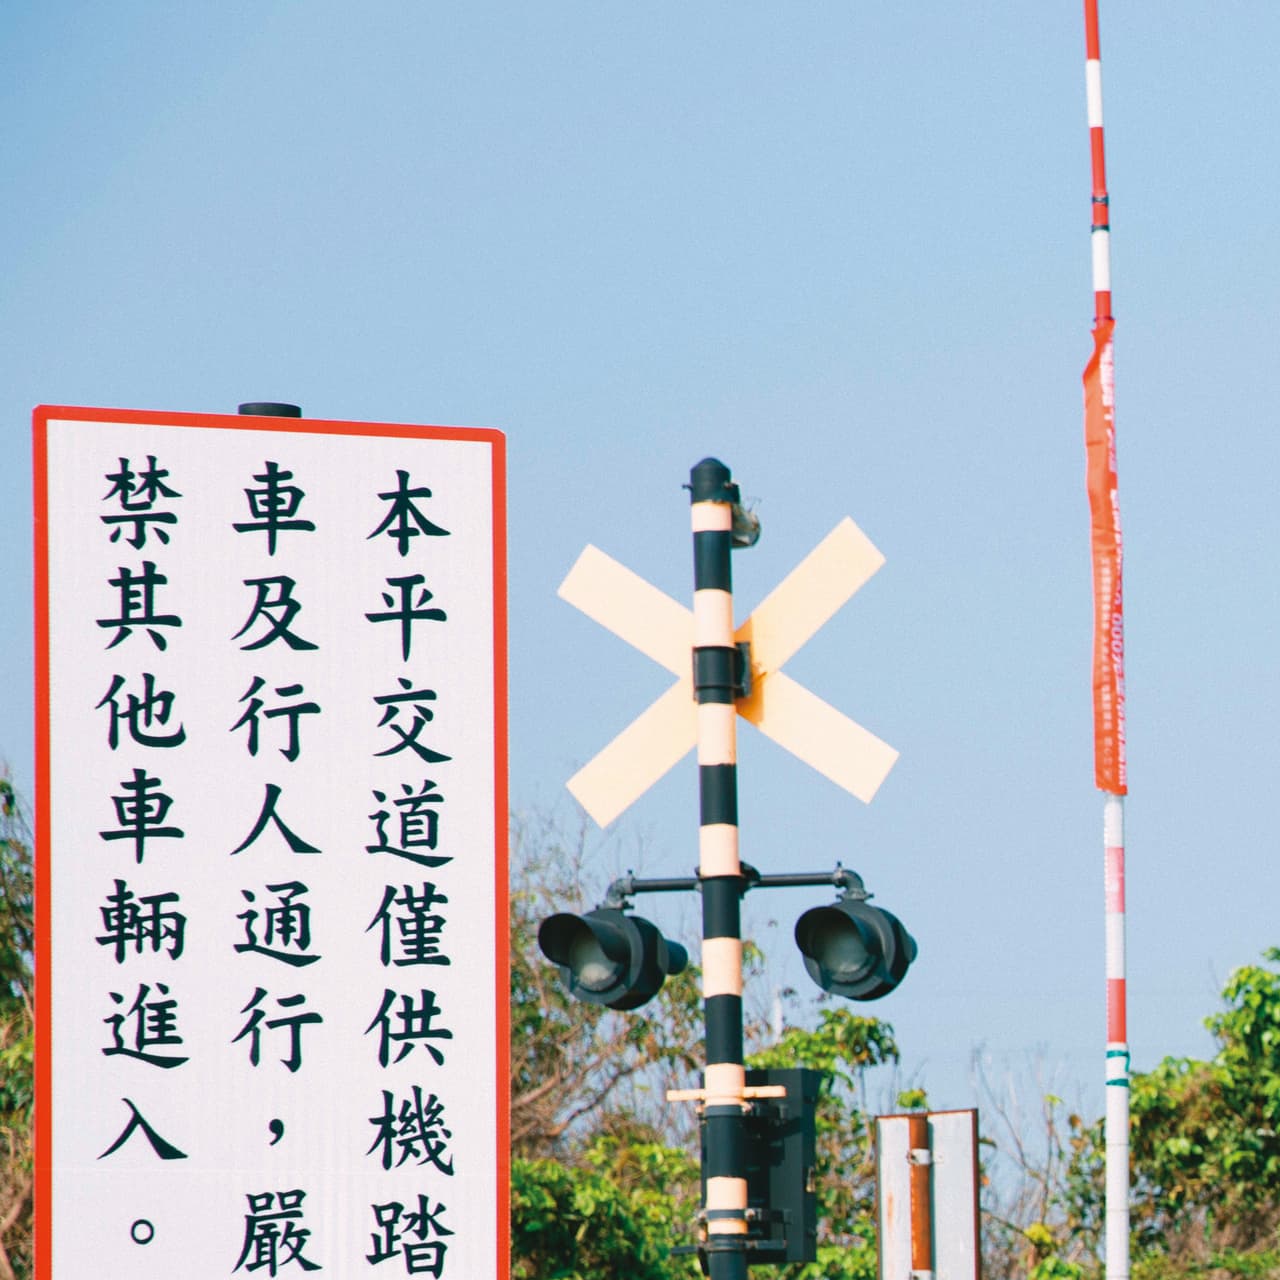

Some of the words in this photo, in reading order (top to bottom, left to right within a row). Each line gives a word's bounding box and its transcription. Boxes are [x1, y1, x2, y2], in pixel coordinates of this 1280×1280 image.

[95, 455, 190, 1246] 禁其他車輛進入。
[229, 460, 324, 1279] 車及行人通行，嚴
[365, 469, 455, 1280] 本平交道僅供機踏
